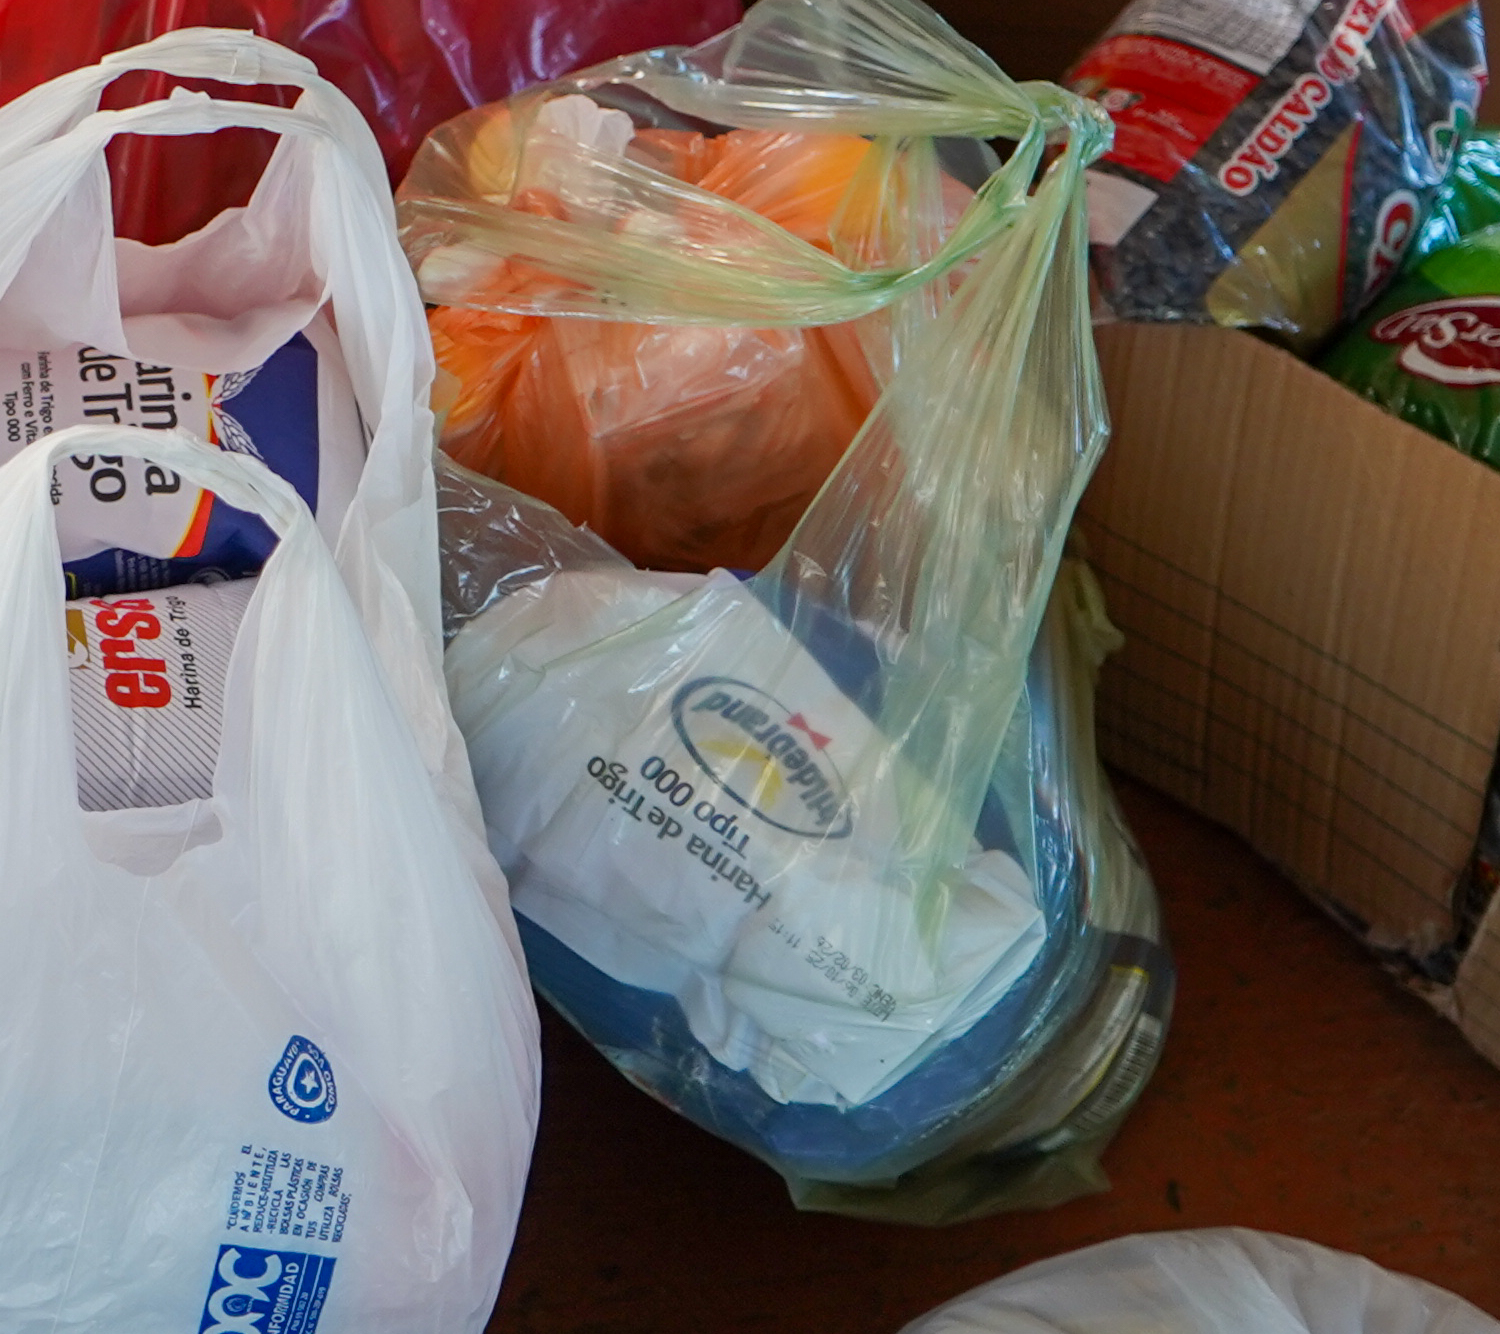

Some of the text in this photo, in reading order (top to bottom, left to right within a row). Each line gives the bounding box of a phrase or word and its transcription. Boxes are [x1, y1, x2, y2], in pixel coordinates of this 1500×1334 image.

[1220, 73, 1329, 197] CALDÃO
[2, 391, 22, 442] Tipo 000
[20, 380, 36, 407] Ferro
[39, 380, 52, 393] de
[39, 395, 56, 424] Trigo
[182, 641, 204, 709] Harina
[582, 748, 773, 911] Harina de Trigo
[637, 752, 757, 860] Tipo 000
[272, 1040, 300, 1114] PARAGUAYO
[240, 1143, 251, 1154] EL
[279, 1152, 290, 1168] LAS
[279, 1157, 303, 1234] BOLSAS PLÁSTICAS
[292, 1161, 316, 1235] EN OCASIÓN DE
[305, 1164, 329, 1238] TUS COMPRAS
[318, 1167, 342, 1240] UTILIZA BOLSAS
